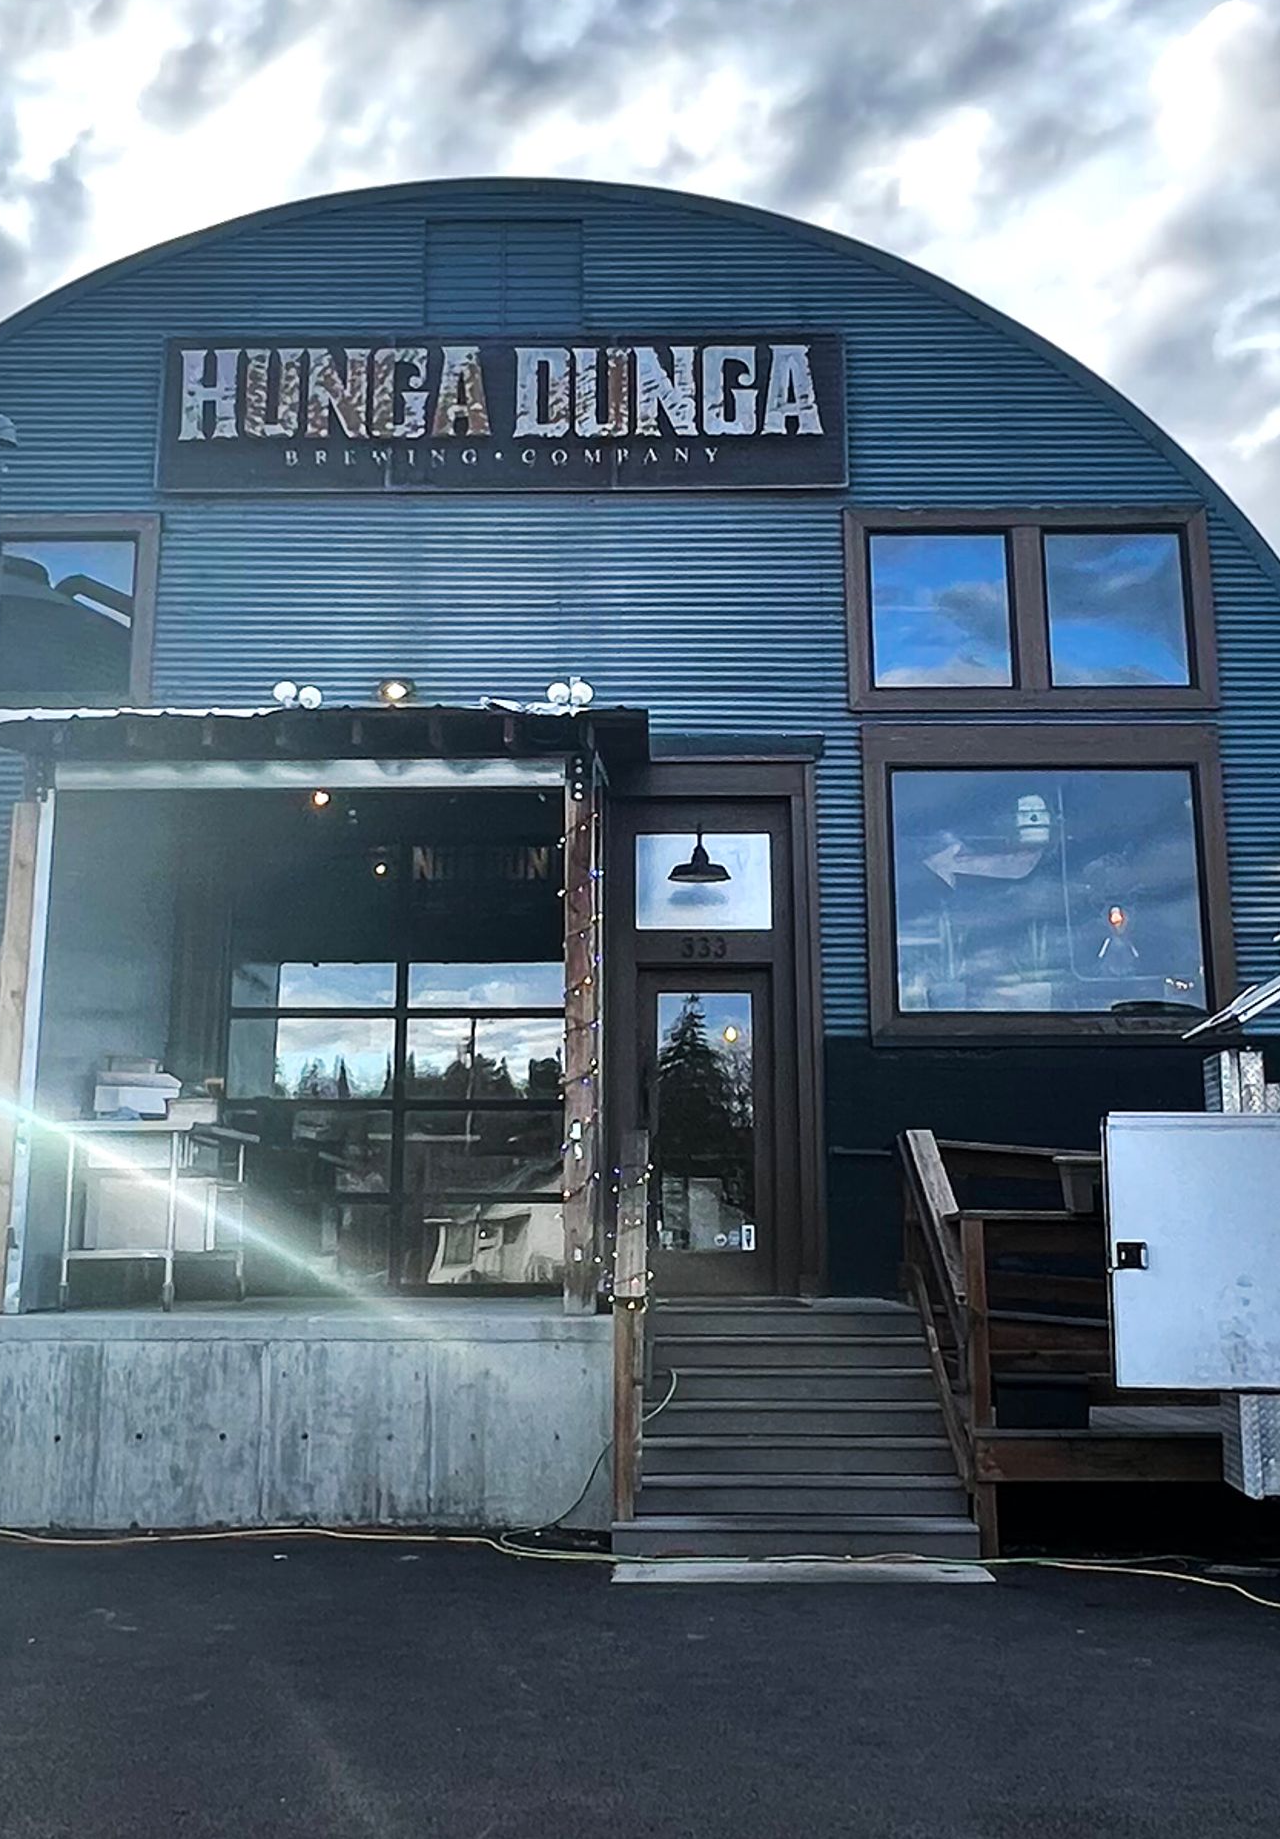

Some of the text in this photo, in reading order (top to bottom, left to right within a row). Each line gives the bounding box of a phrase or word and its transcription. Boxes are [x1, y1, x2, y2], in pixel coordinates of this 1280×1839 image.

[177, 344, 825, 441] HUNGA DUNGA
[284, 445, 722, 468] BREWING COMPANY
[680, 936, 728, 960] 333
